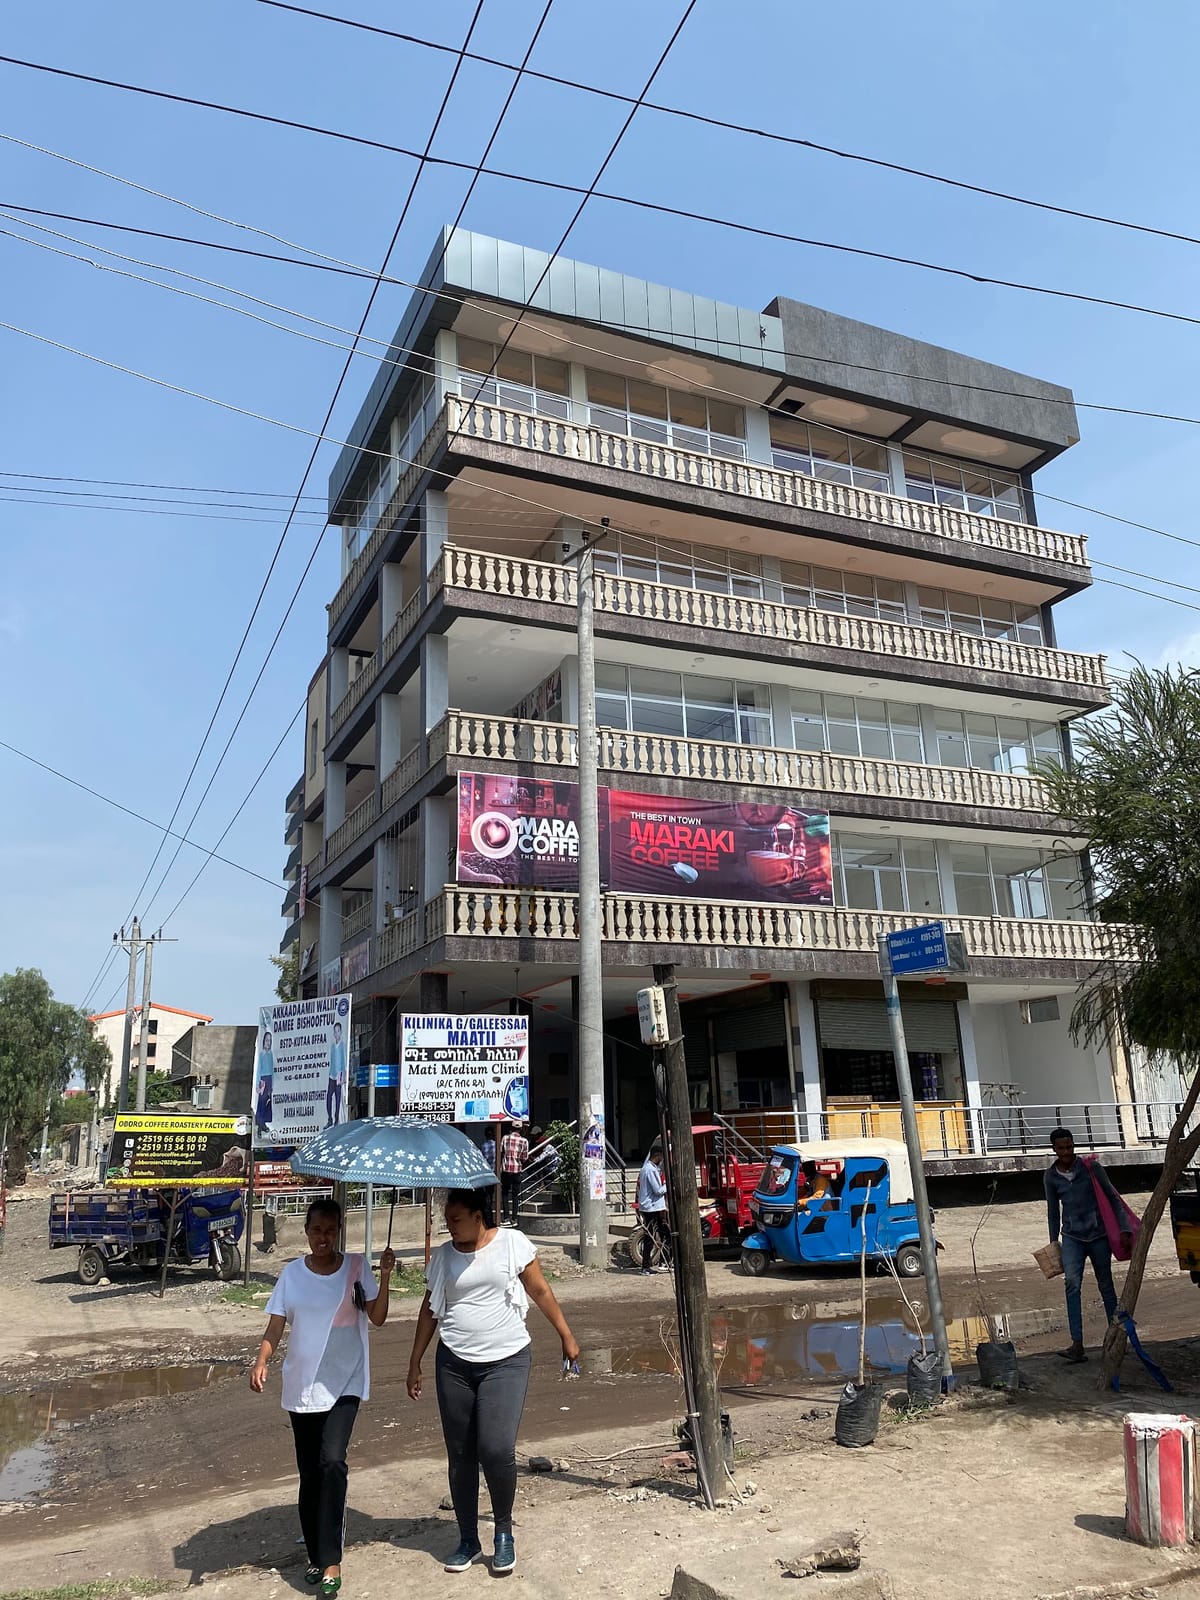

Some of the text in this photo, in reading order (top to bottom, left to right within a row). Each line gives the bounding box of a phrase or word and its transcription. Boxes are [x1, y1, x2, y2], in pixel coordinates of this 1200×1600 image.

[630, 811, 702, 826] THE BEST IN TOWN
[519, 816, 580, 839] MARA
[630, 821, 735, 853] MARAKI
[518, 834, 580, 857] COFFE
[630, 845, 720, 872] COFFEE
[273, 1002, 315, 1018] AKKAADAAMII
[273, 1012, 335, 1033] DAMEE BISHOOFTUU
[404, 1018, 527, 1030] KILINIKA G/GALEESSAA
[447, 1031, 496, 1046] MAATII
[276, 1052, 327, 1063] WALIF ACADEMY
[405, 1048, 428, 1060] ማቲ
[486, 1048, 518, 1061] ክሊኒክ
[274, 1061, 330, 1073] BISHOFTU BRANCH
[408, 1063, 438, 1075] Mati
[441, 1063, 488, 1075] Medium
[491, 1063, 526, 1075] Clinic
[284, 1072, 315, 1080] KG-GRADE
[400, 1101, 455, 1111] 011-8481-534
[423, 1112, 451, 1122] 313483
[170, 1121, 204, 1129] ROASTERY
[137, 1135, 162, 1143] +2519
[163, 1135, 174, 1143] 66
